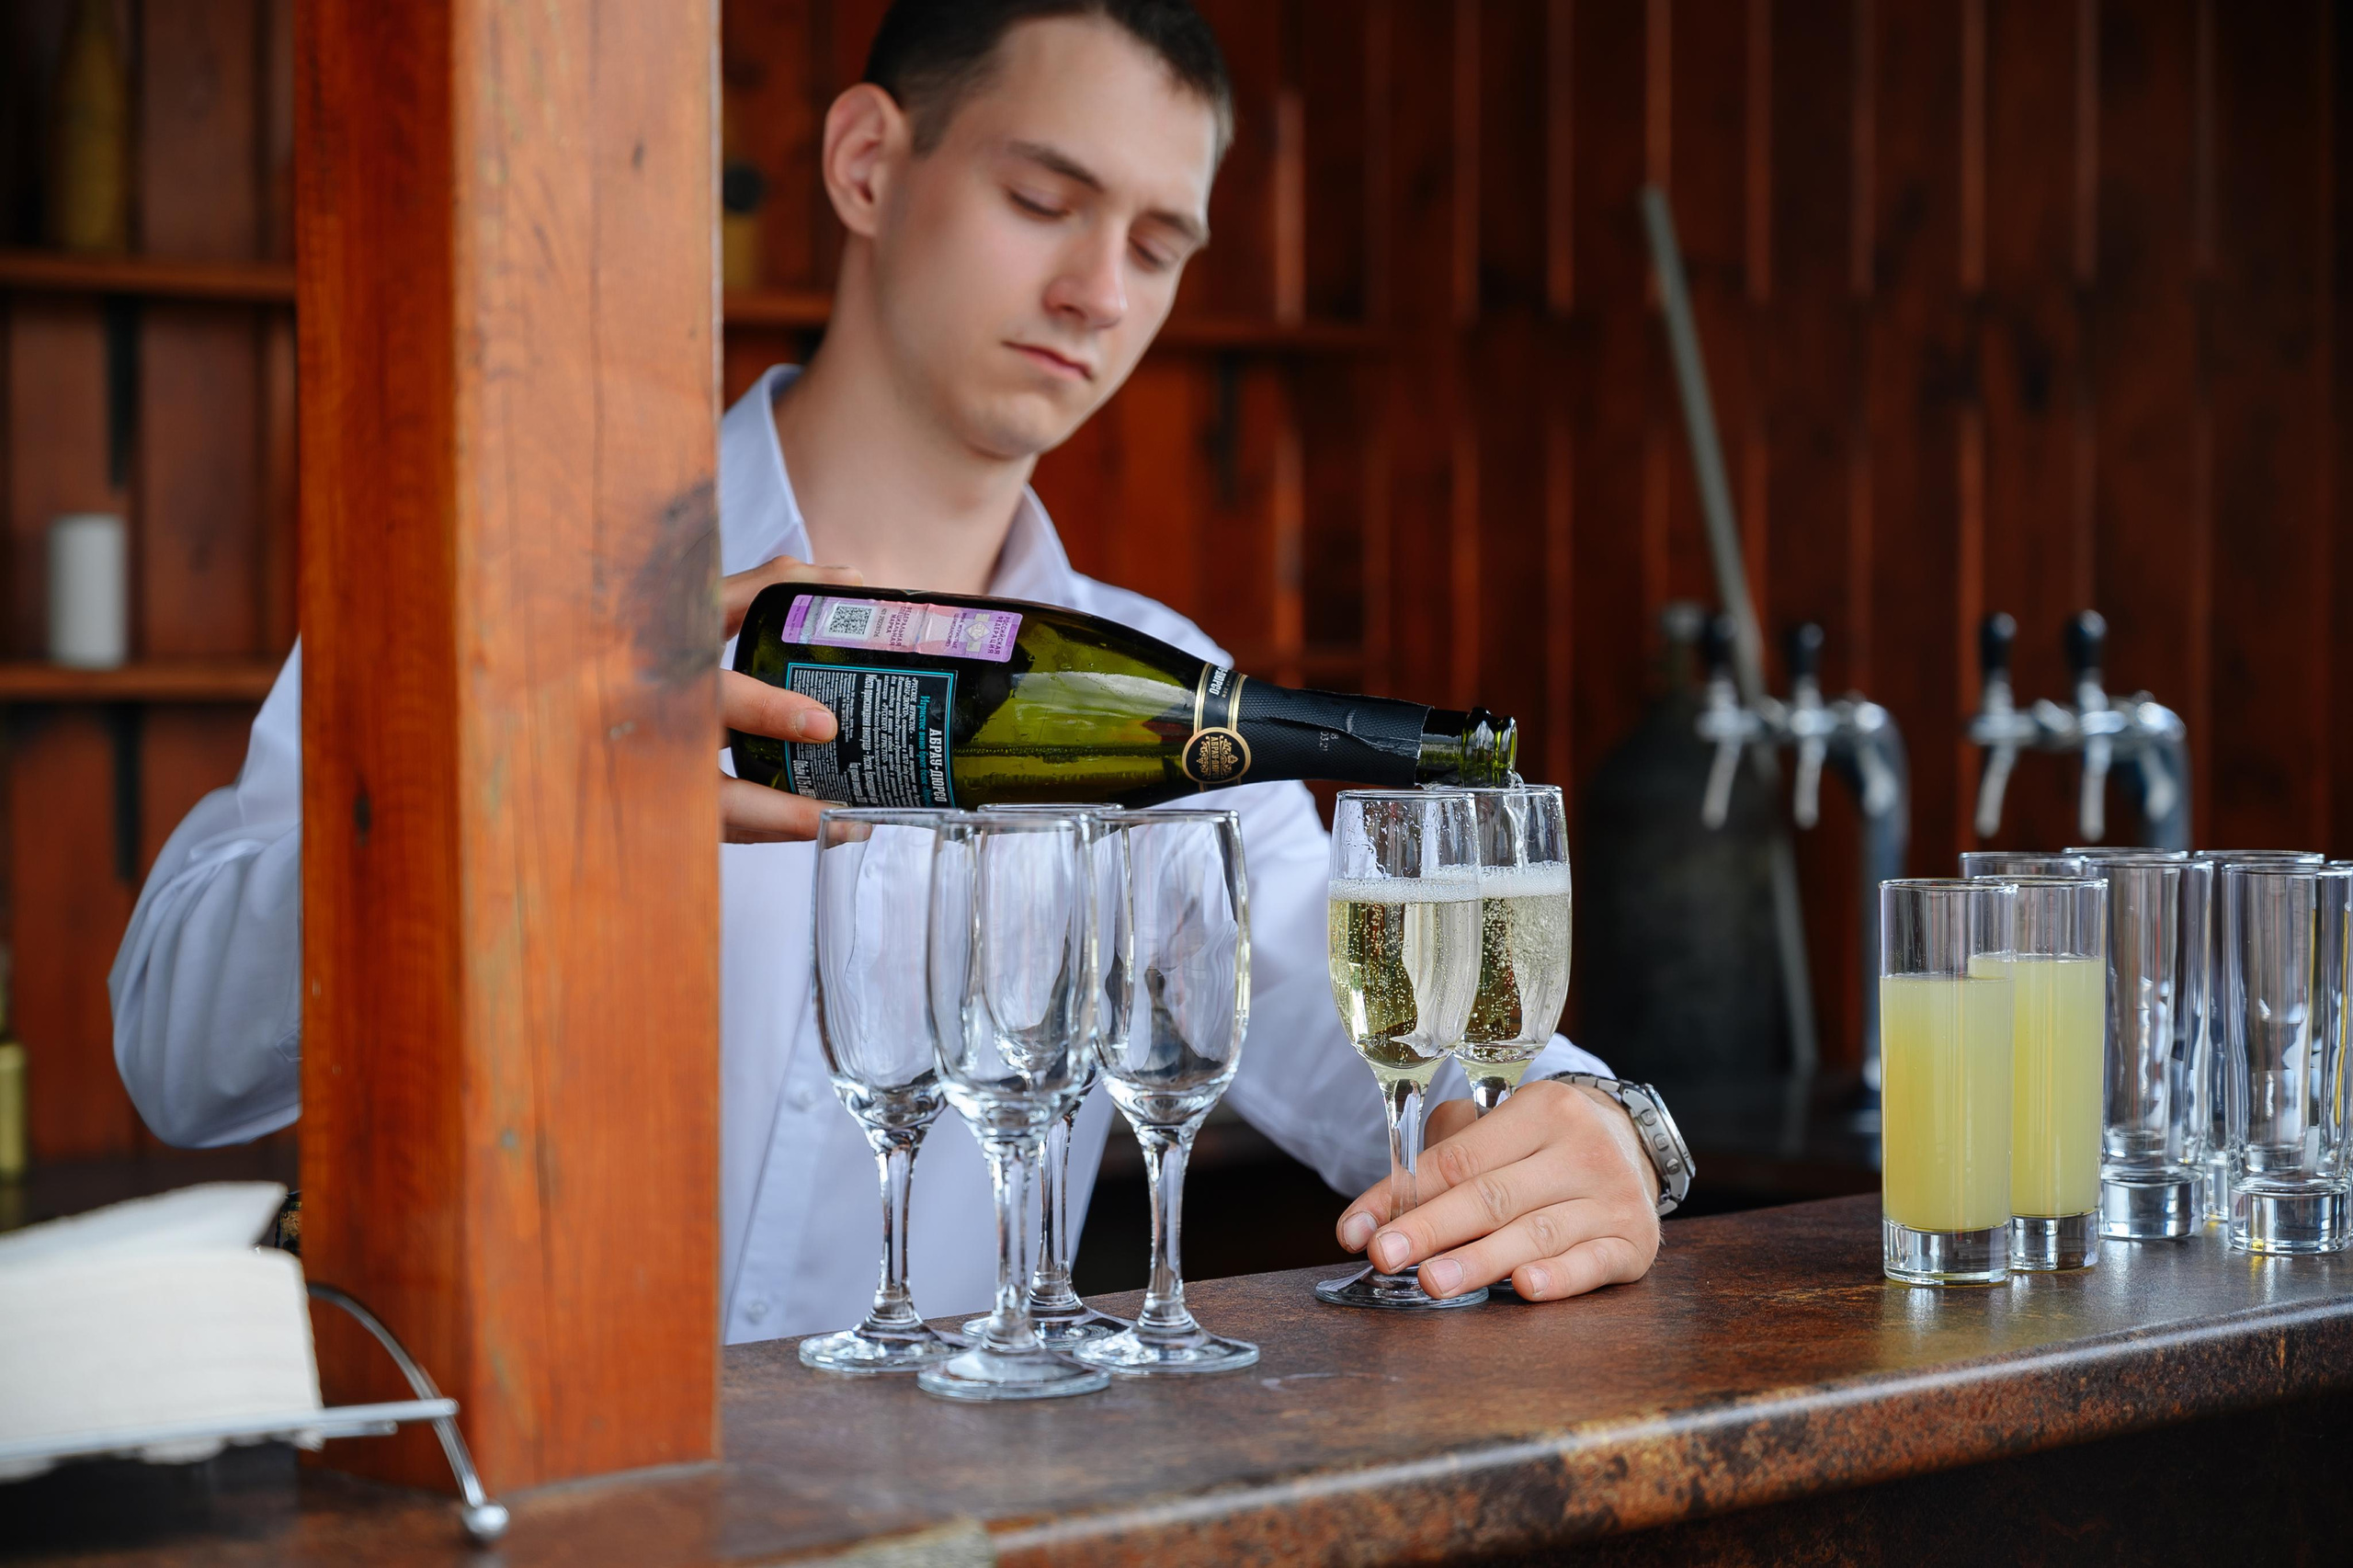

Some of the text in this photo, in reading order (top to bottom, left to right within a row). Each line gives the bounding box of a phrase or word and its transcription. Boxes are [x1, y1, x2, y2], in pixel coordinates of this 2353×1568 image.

[886, 614, 896, 633] МАРКА
[889, 607, 906, 645] СПЕЦИАЛЬНАЯ
[895, 607, 912, 646] ФЕДЕРАЛЬНАЯ
[988, 616, 1003, 653] ФЕДЕРАЦИЯ
[995, 617, 1010, 654] РОССИЙСКАЯ
[917, 696, 930, 730] Игристое
[916, 751, 928, 767] брют
